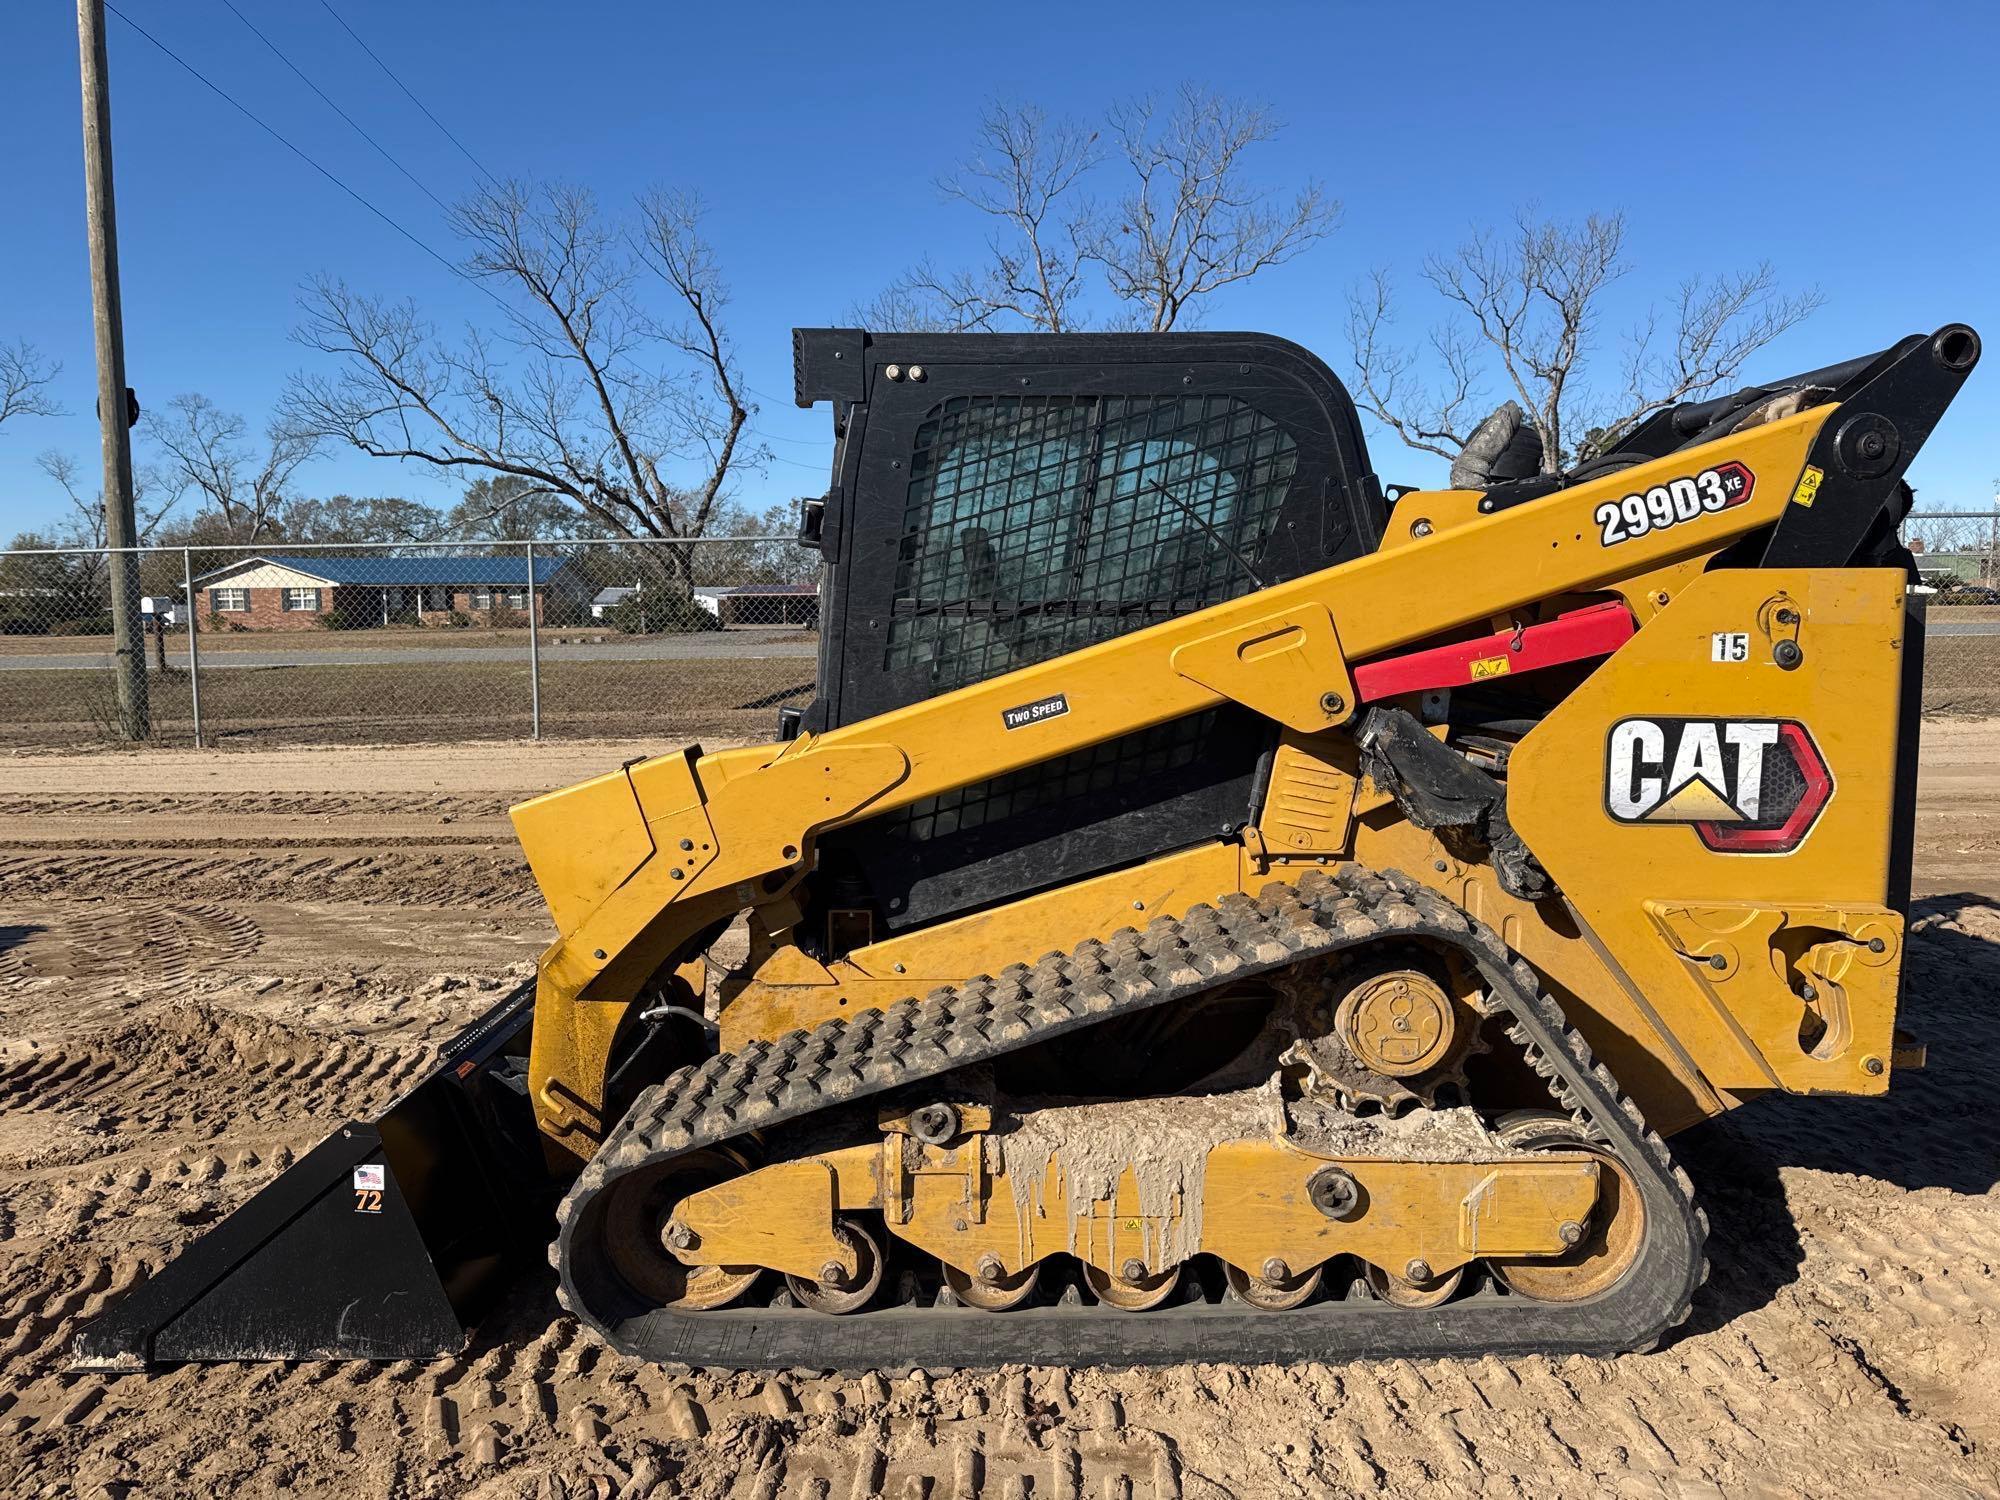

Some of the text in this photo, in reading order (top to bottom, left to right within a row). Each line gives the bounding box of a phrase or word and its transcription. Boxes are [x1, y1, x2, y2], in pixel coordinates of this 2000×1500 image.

[1597, 471, 1742, 545] 299D3 XE
[1718, 634, 1746, 661] 15
[1610, 720, 1779, 820] CAT
[355, 1190, 382, 1211] 72
